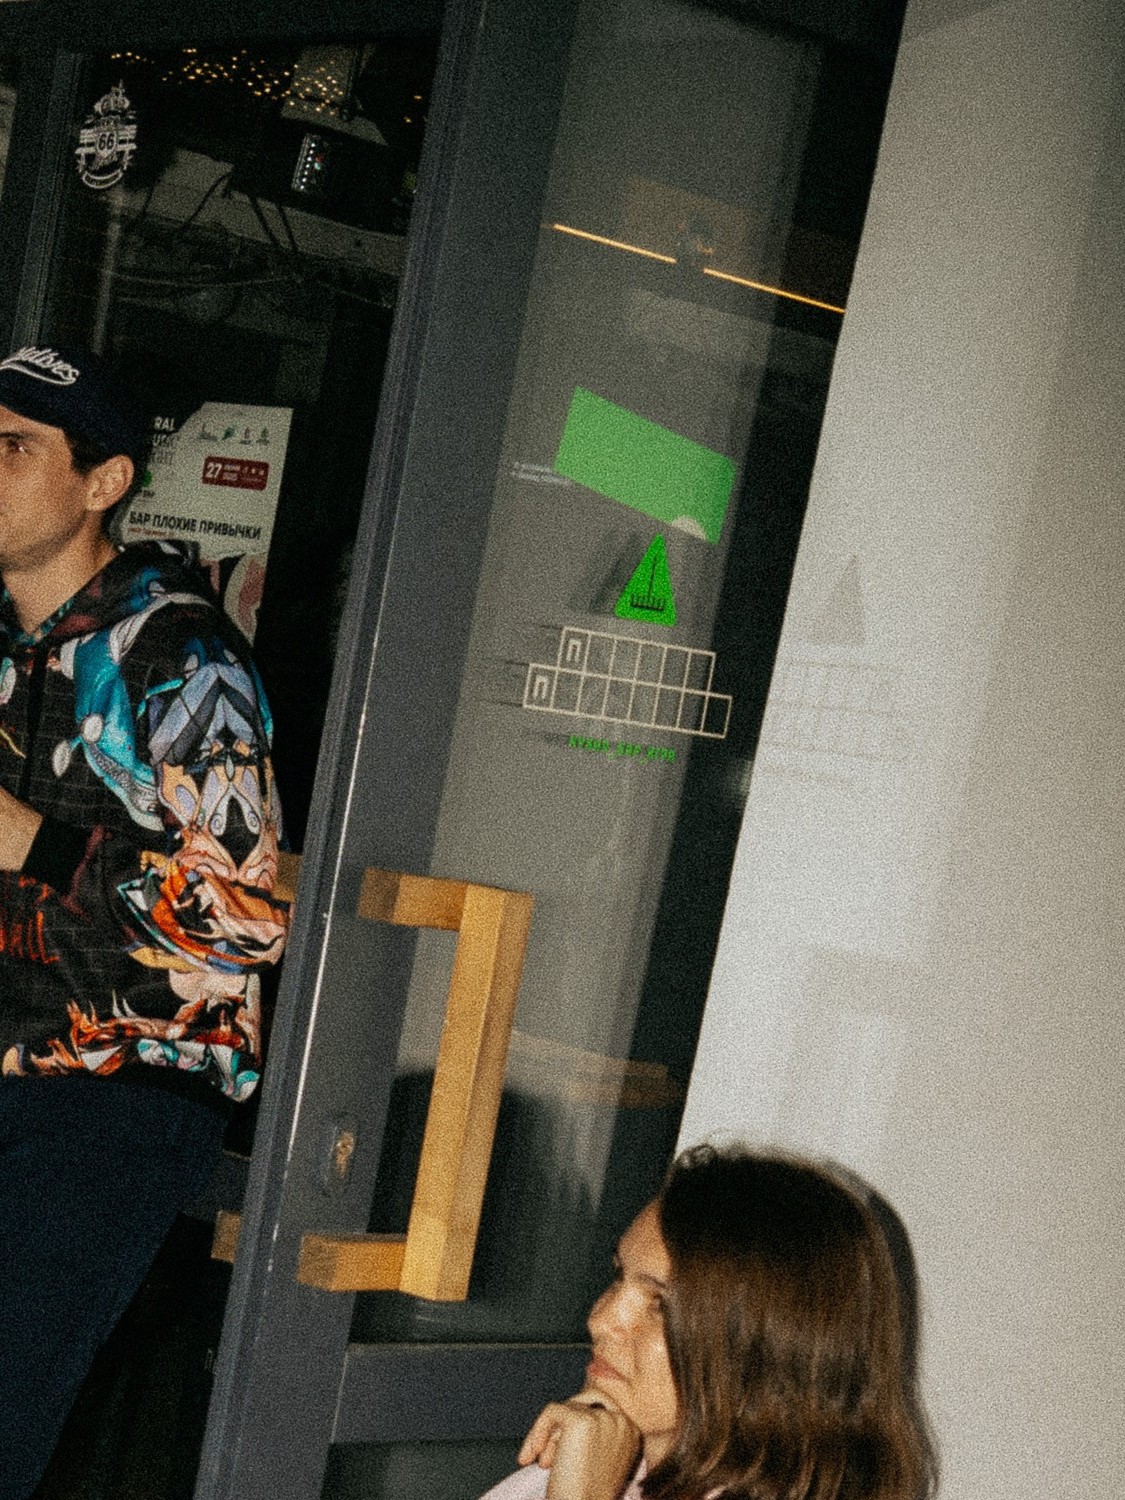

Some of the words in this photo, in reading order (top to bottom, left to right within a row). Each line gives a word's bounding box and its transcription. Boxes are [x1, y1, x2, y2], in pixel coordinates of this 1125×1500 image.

[98, 133, 115, 151] 66
[204, 461, 223, 478] 27
[129, 511, 151, 524] БАР
[152, 514, 197, 532] ПЛОХИЕ
[199, 520, 262, 540] ПРИВЫЧКИ
